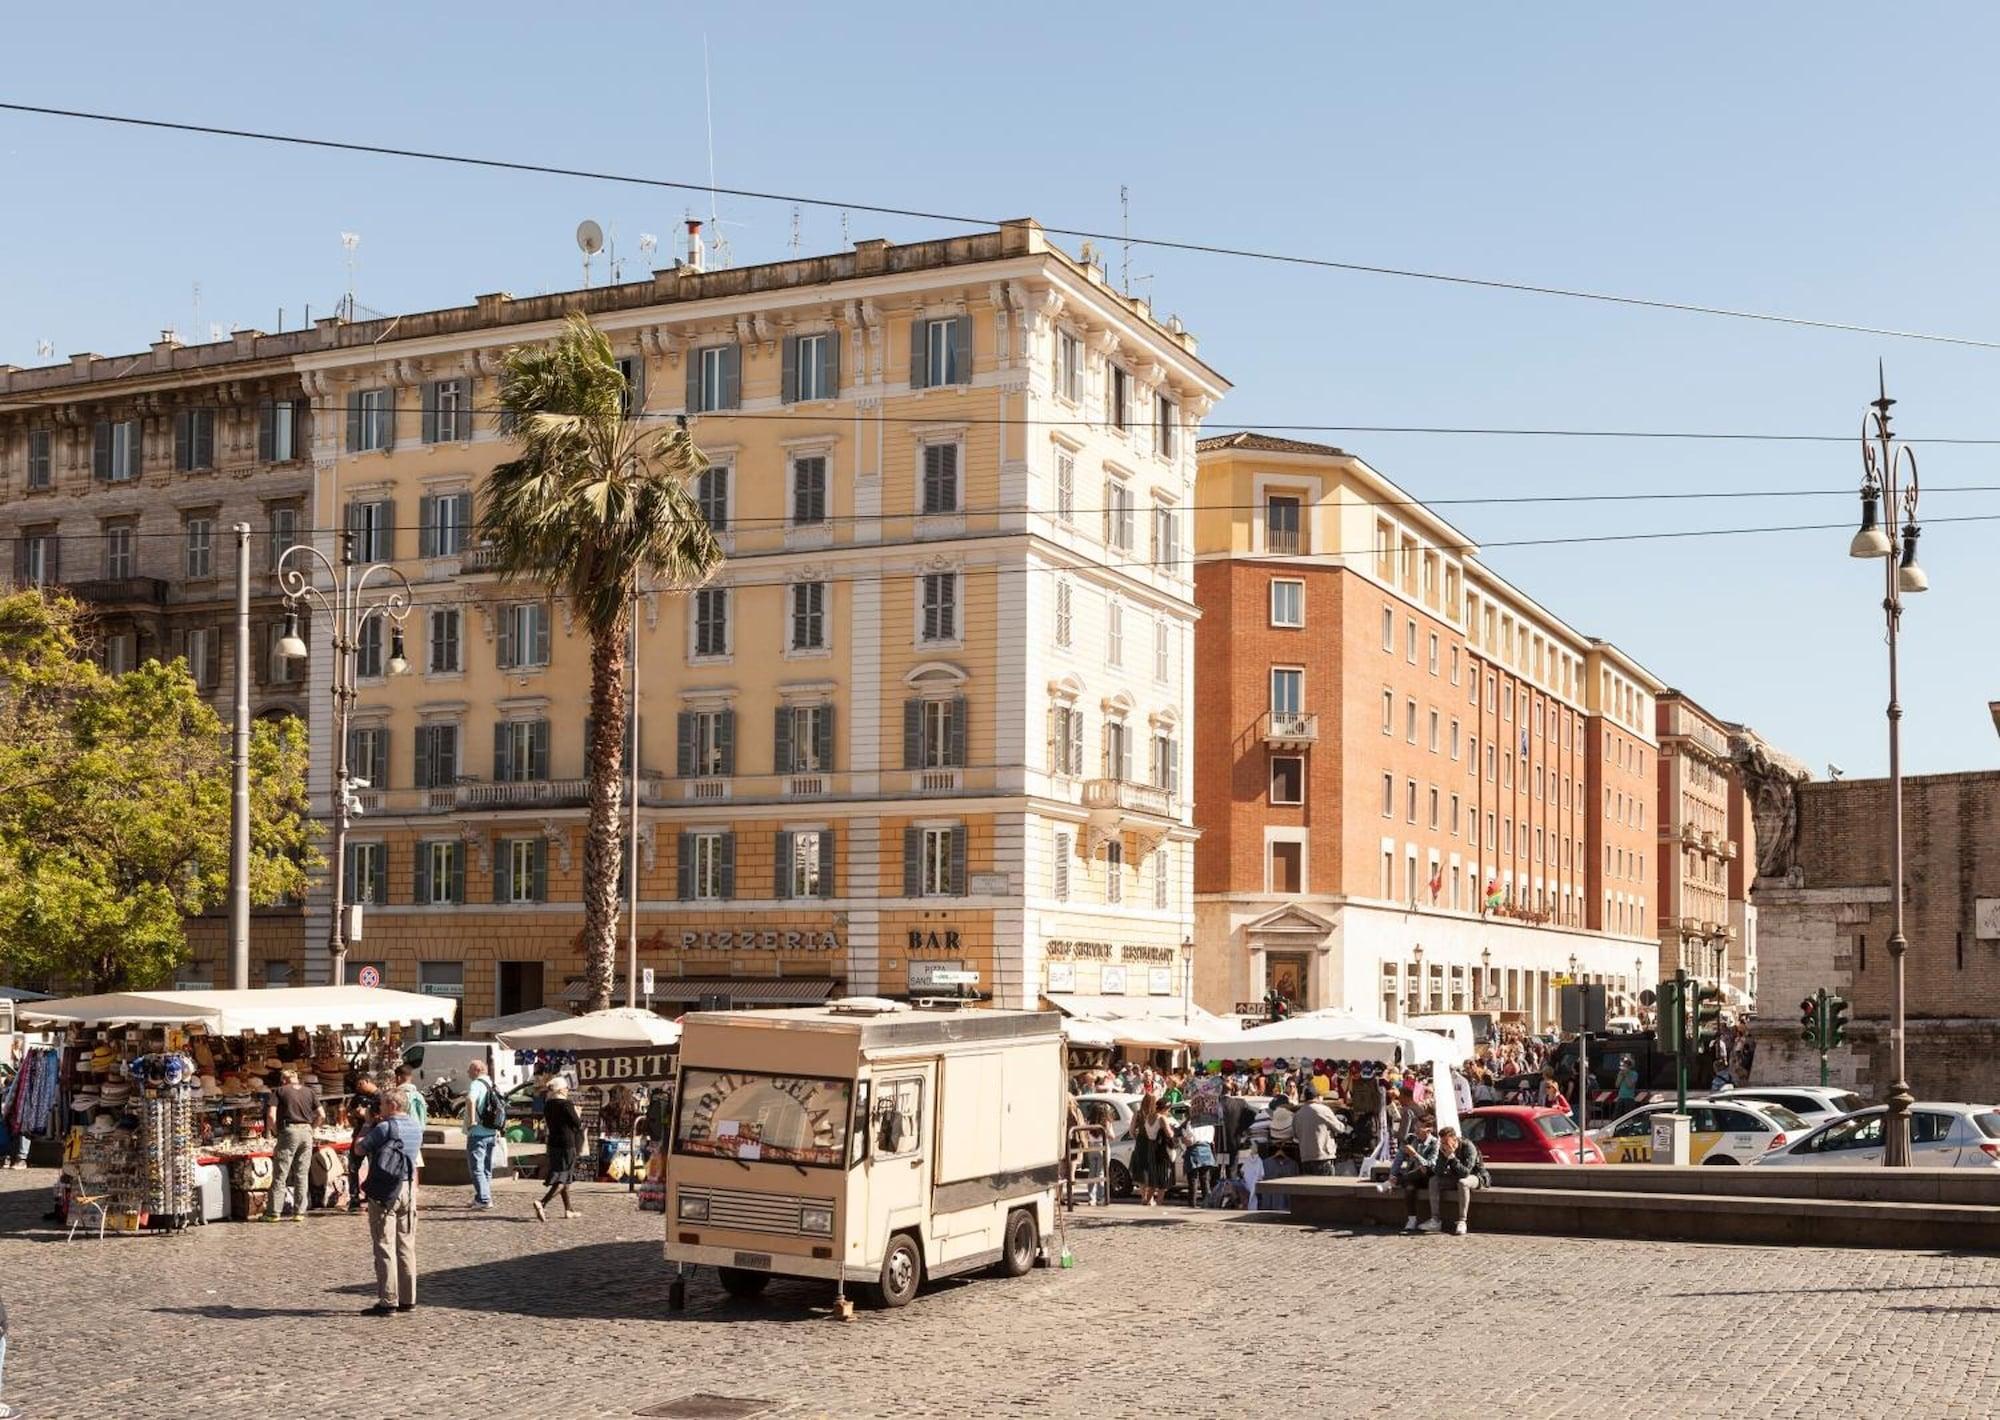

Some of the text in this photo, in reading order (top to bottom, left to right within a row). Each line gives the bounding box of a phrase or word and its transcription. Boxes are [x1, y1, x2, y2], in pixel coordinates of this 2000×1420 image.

[681, 931, 840, 950] PIZZERIA
[908, 930, 961, 950] BAR
[1121, 944, 1175, 964] RESTAURANT
